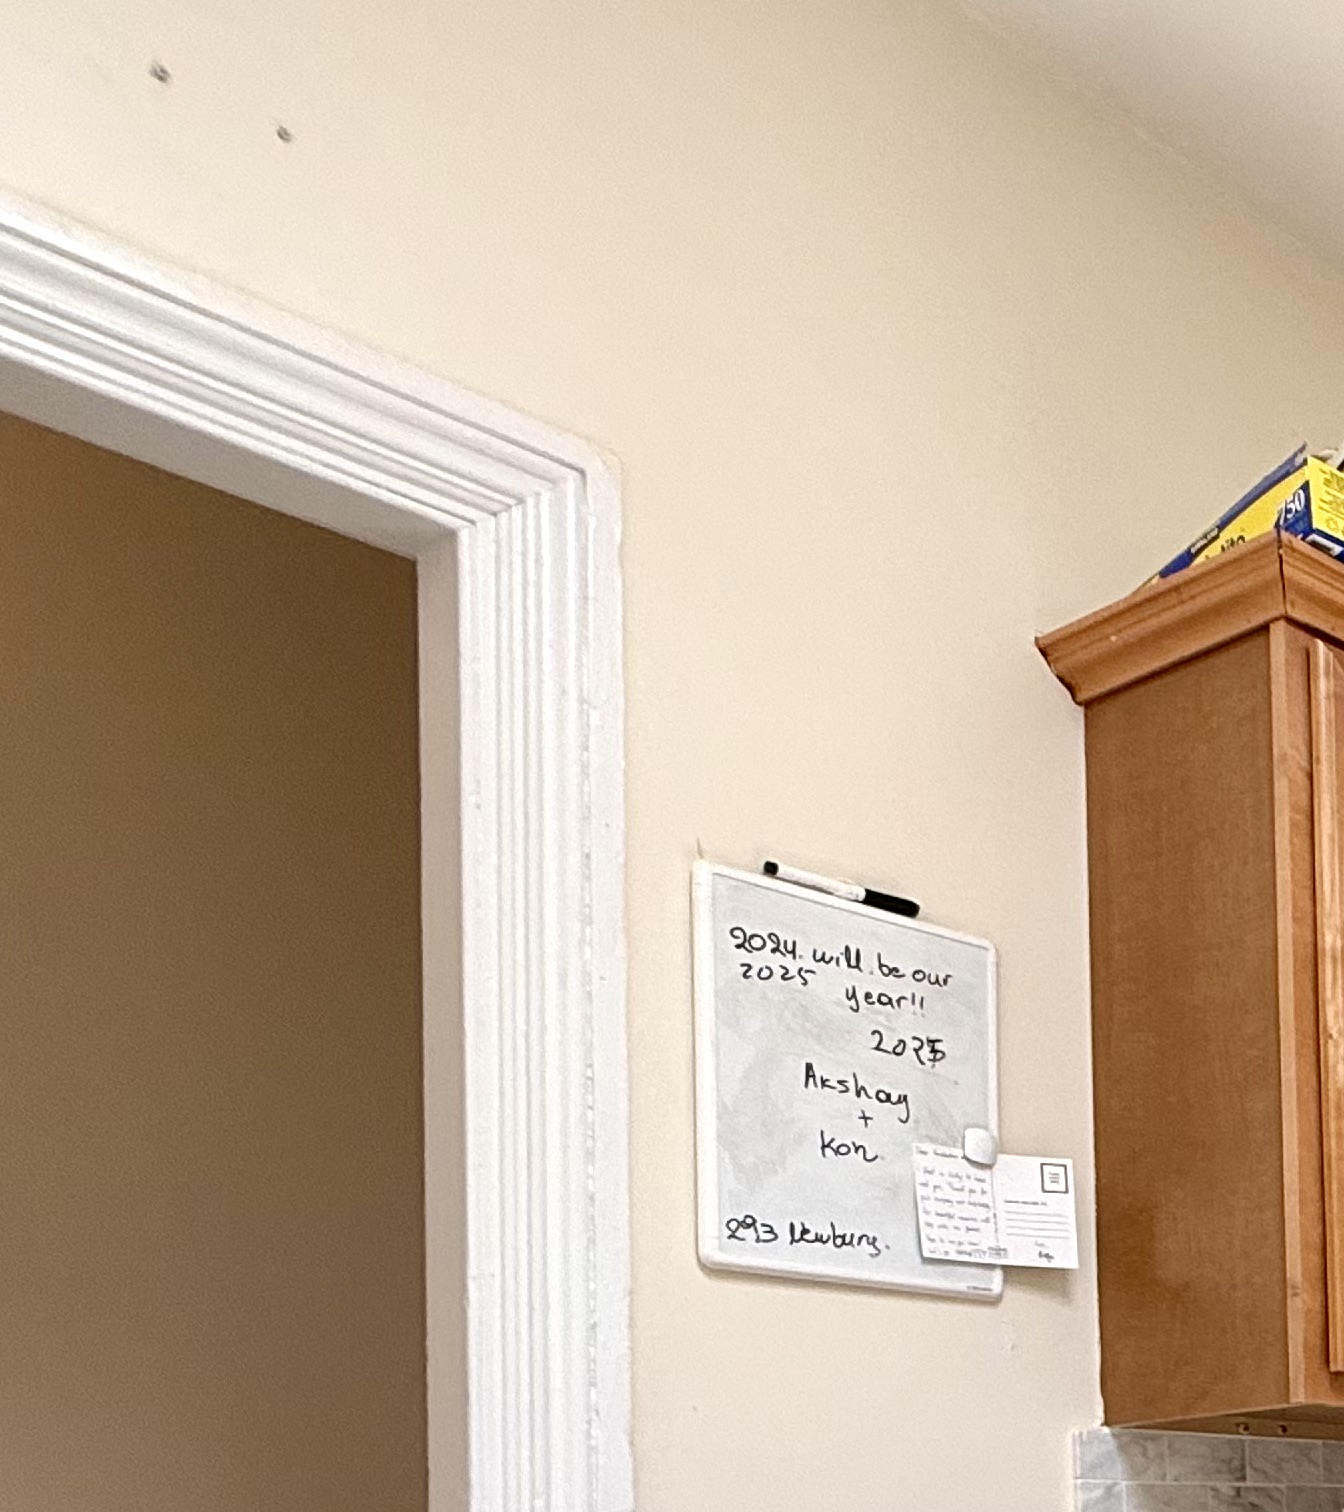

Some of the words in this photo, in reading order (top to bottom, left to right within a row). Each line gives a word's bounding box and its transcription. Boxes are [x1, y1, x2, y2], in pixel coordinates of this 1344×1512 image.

[740, 963, 817, 986] 2025
[877, 952, 906, 979] be
[911, 968, 954, 987] our
[845, 985, 926, 1018] year!!
[804, 1062, 910, 1124] Akshay
[725, 1214, 779, 1243] 293
